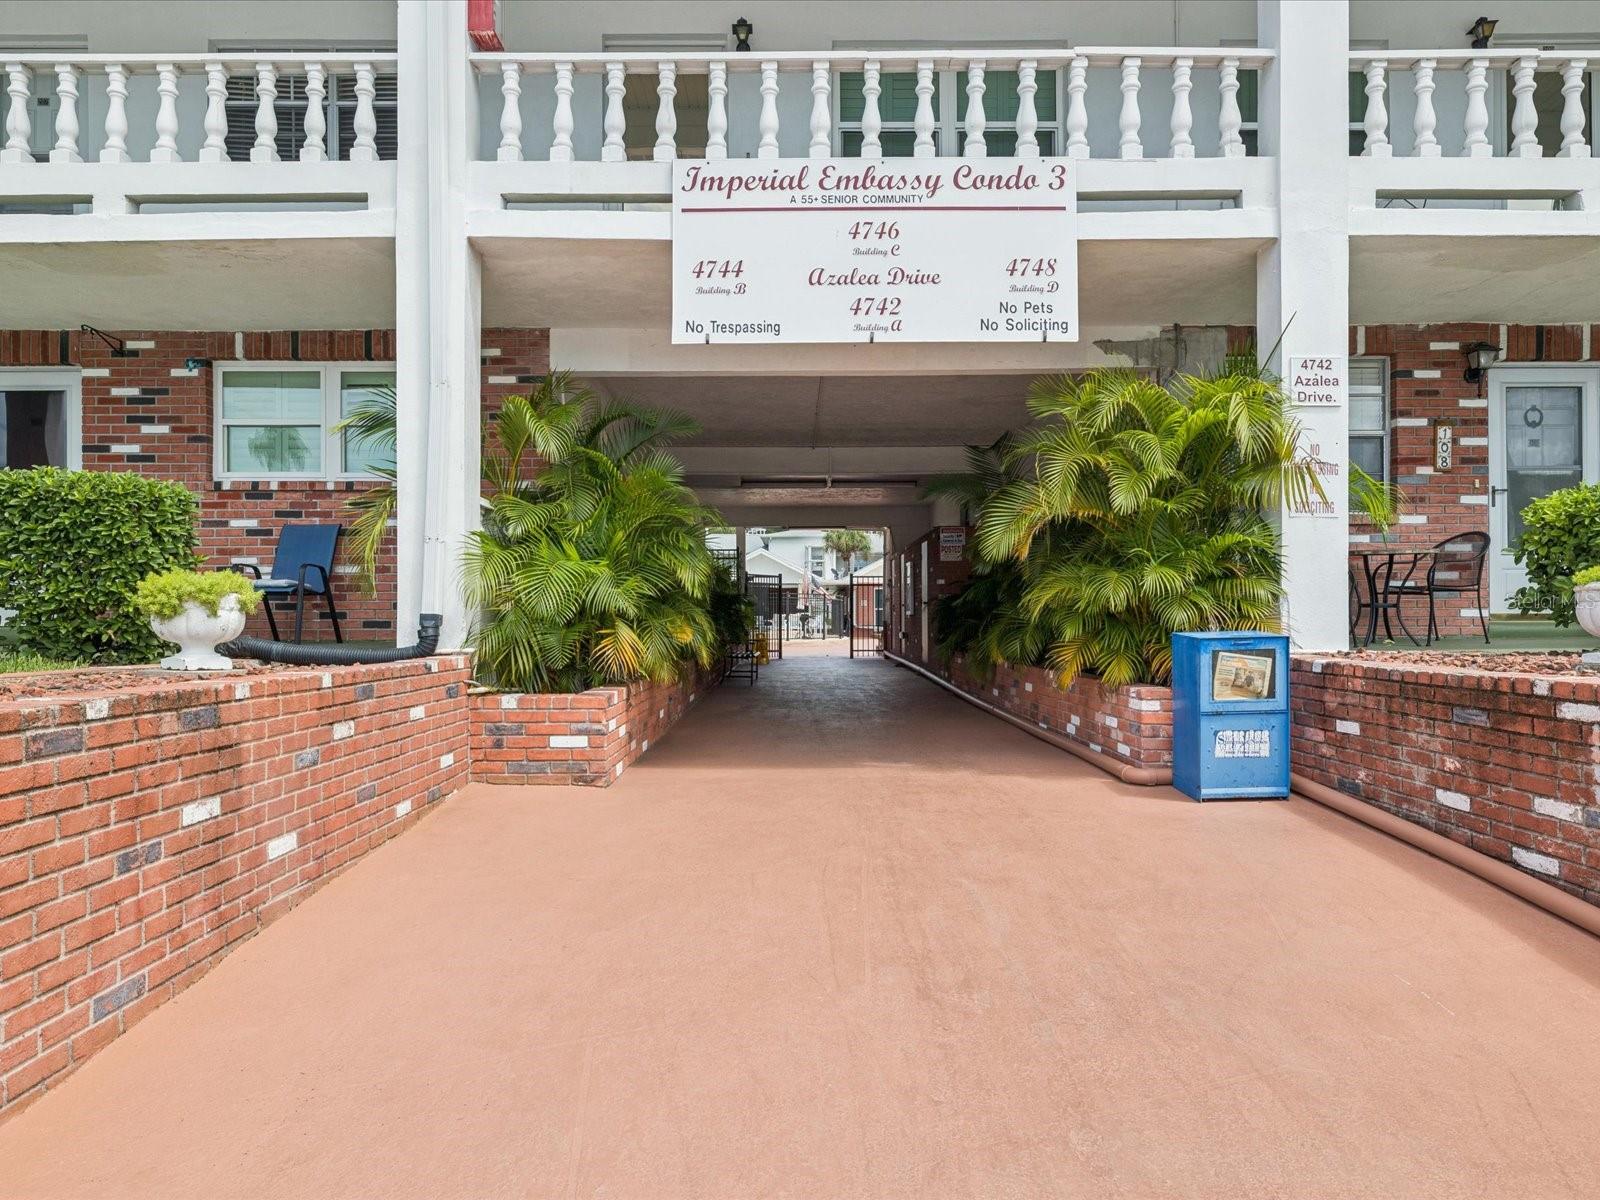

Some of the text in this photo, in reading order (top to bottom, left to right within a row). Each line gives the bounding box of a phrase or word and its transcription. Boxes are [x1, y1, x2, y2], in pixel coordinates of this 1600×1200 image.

[681, 164, 1067, 199] Imperial Embassy Condo 3
[790, 194, 924, 204] A 55+ SENIOR COMMUNITY
[848, 221, 900, 240] 4746
[852, 244, 900, 257] Building C
[692, 259, 744, 279] 4744
[1005, 257, 1057, 276] 4748
[808, 266, 941, 286] Azalea Drive
[695, 282, 747, 296] Building B
[1008, 280, 1059, 294] Building D
[850, 297, 902, 316] 4742
[999, 301, 1053, 314] No Pets
[685, 319, 781, 336] No Trespassing
[853, 319, 902, 333] Building A
[980, 318, 1069, 333] No Soliciting
[1300, 359, 1332, 370] 4742
[1294, 375, 1339, 387] Azalea
[1297, 391, 1337, 403] Drive.
[1310, 443, 1320, 457] NO
[1439, 428, 1449, 469] 108
